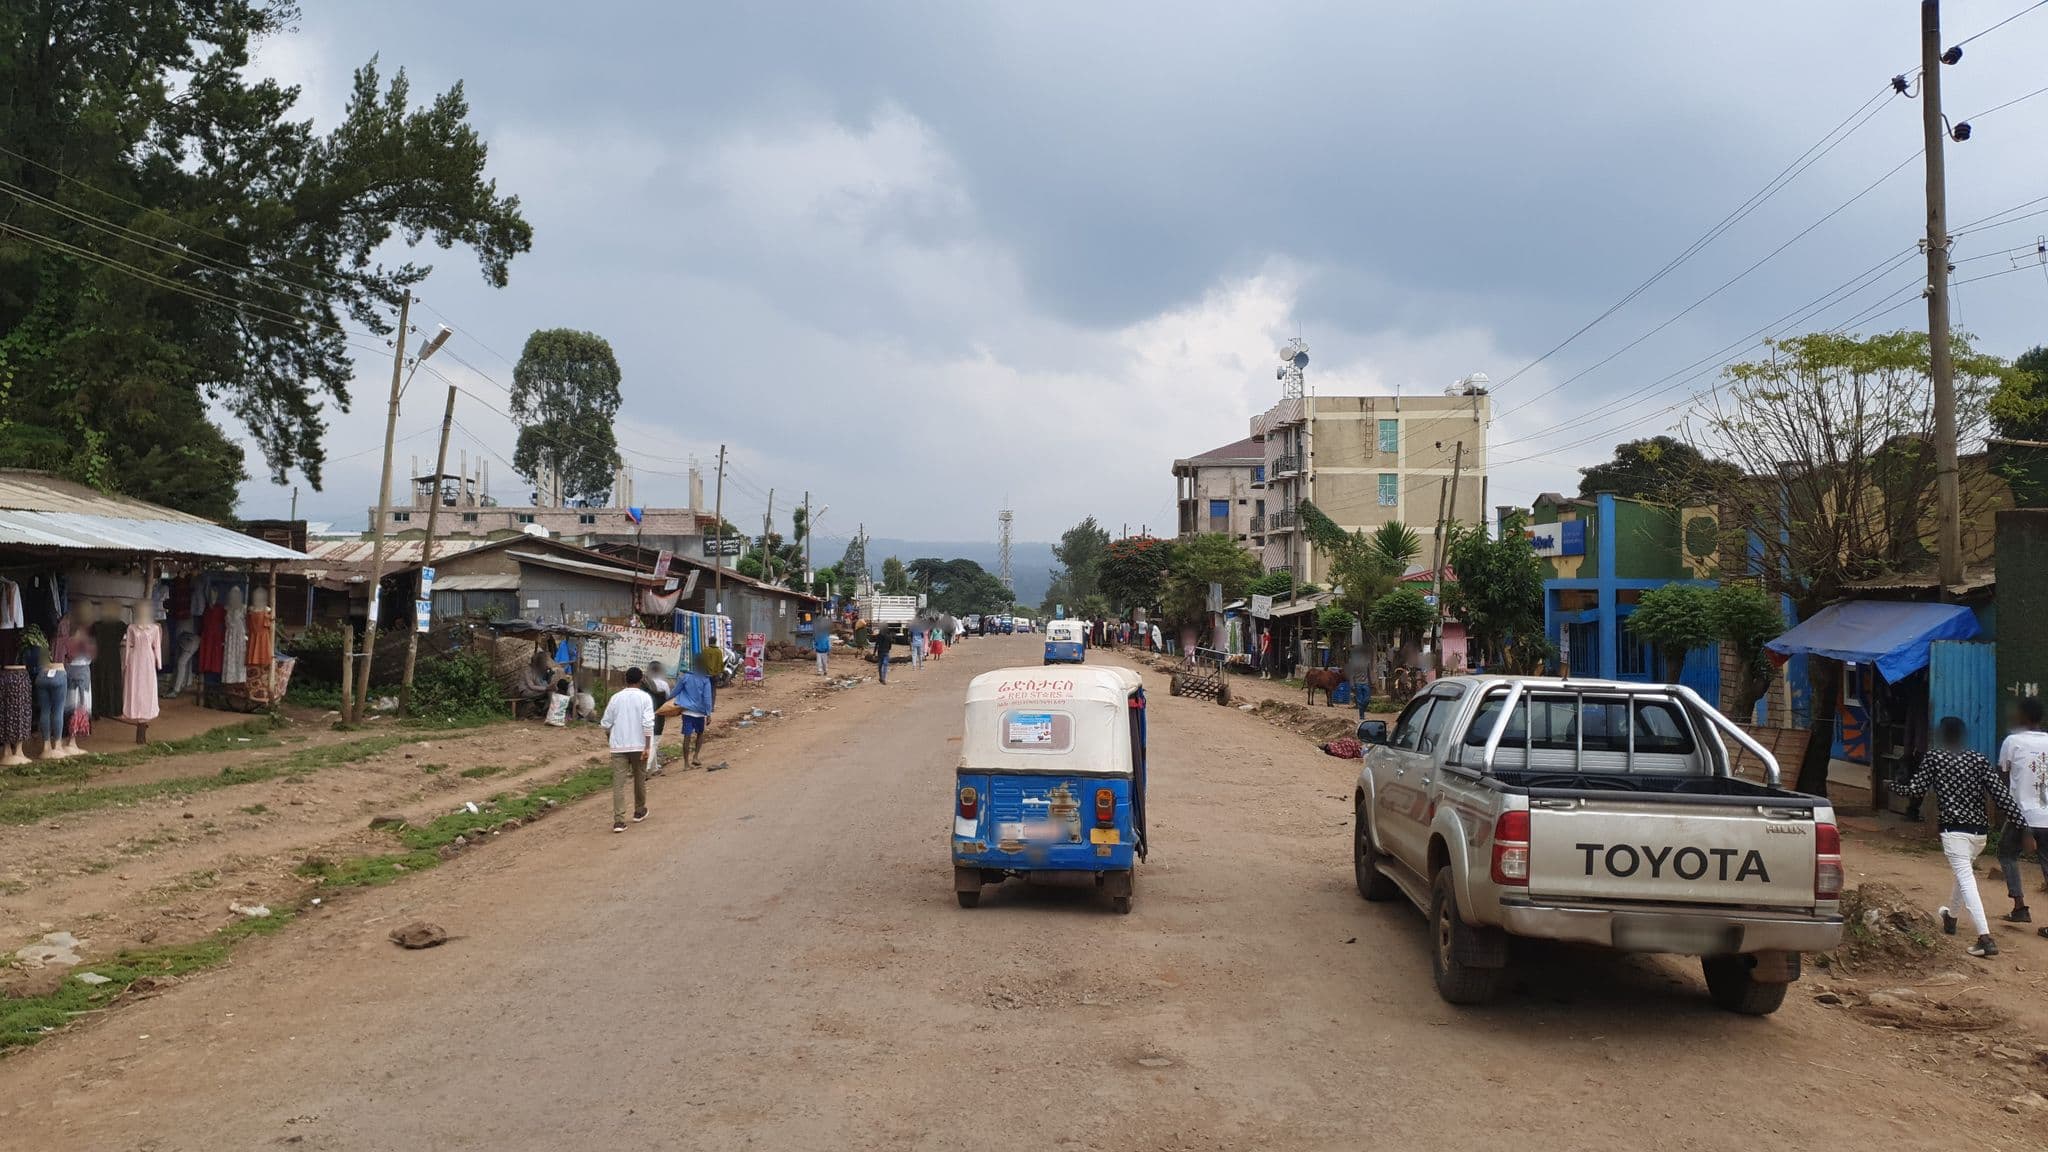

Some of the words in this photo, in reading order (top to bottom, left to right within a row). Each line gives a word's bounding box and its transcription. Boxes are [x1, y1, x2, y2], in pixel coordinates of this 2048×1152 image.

[1008, 691, 1028, 700] RED
[1766, 824, 1807, 835] HILUX
[1576, 843, 1770, 882] TOYOTA
